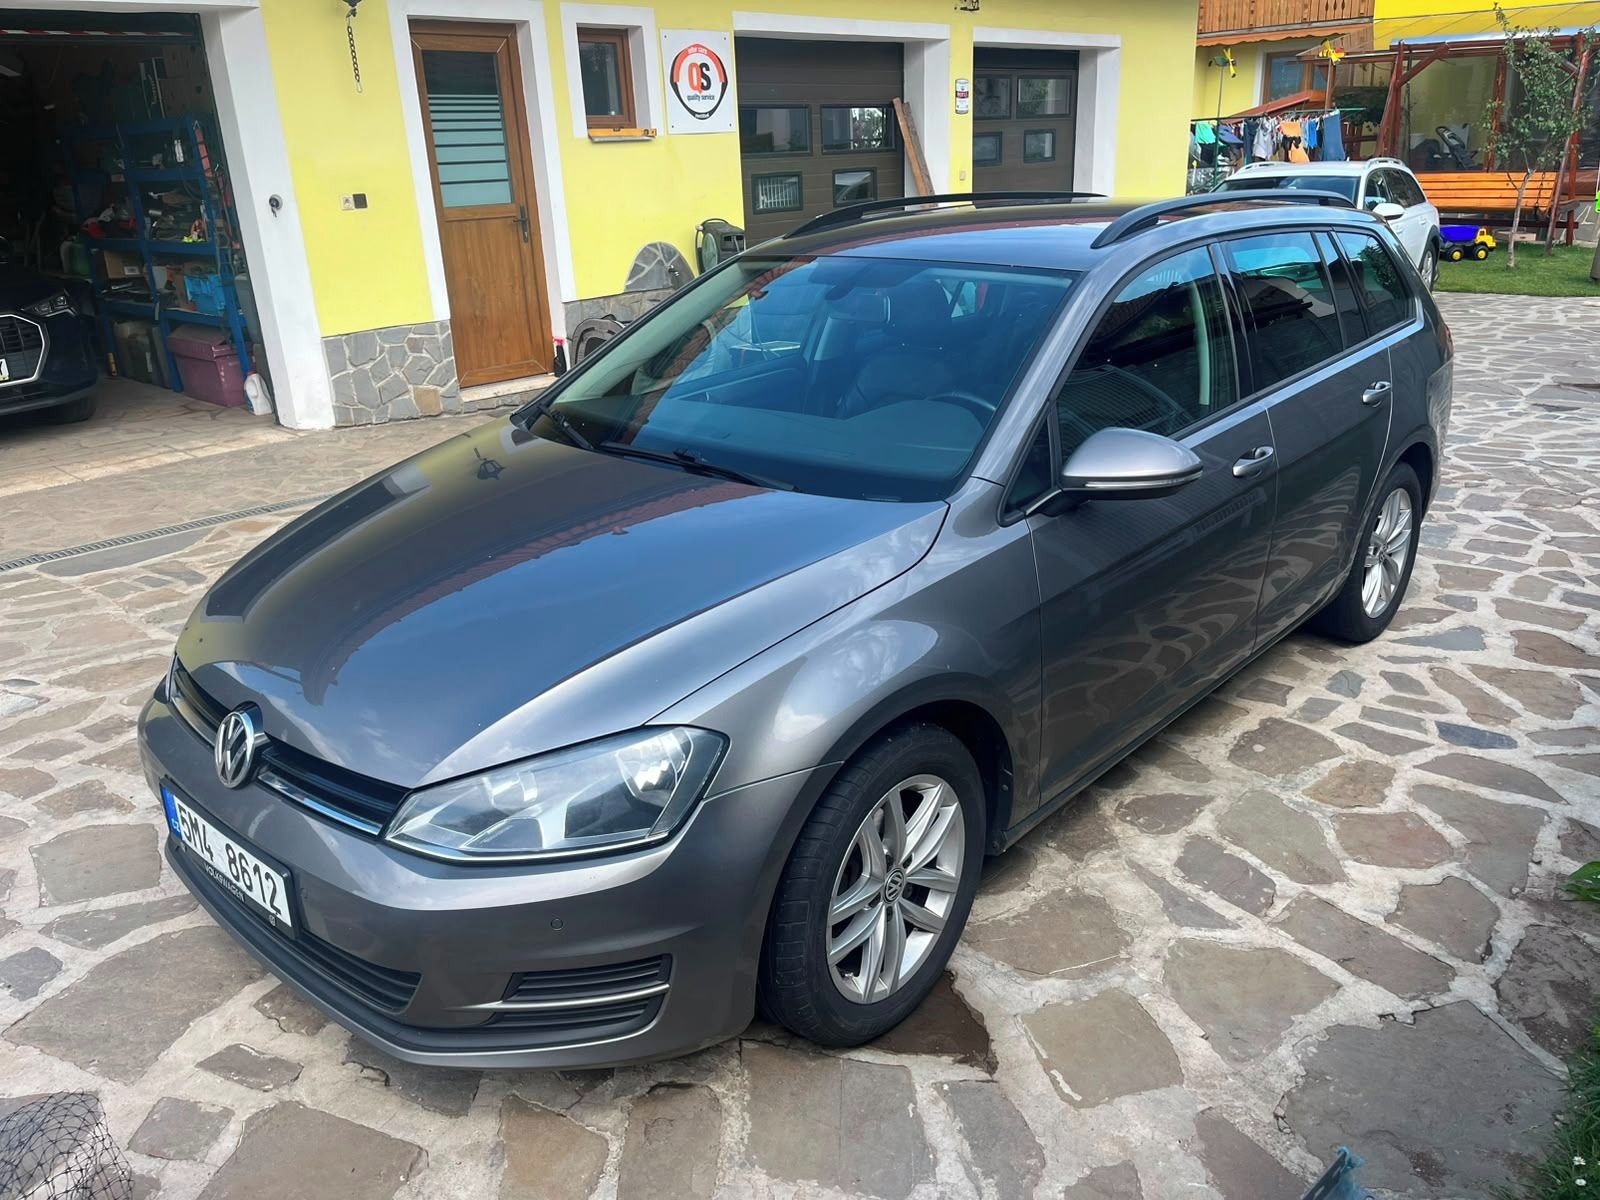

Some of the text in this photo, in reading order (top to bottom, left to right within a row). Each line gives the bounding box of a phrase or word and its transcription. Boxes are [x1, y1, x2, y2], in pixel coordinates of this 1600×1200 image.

[688, 62, 712, 93] QS
[177, 803, 282, 916] 5M4 8612
